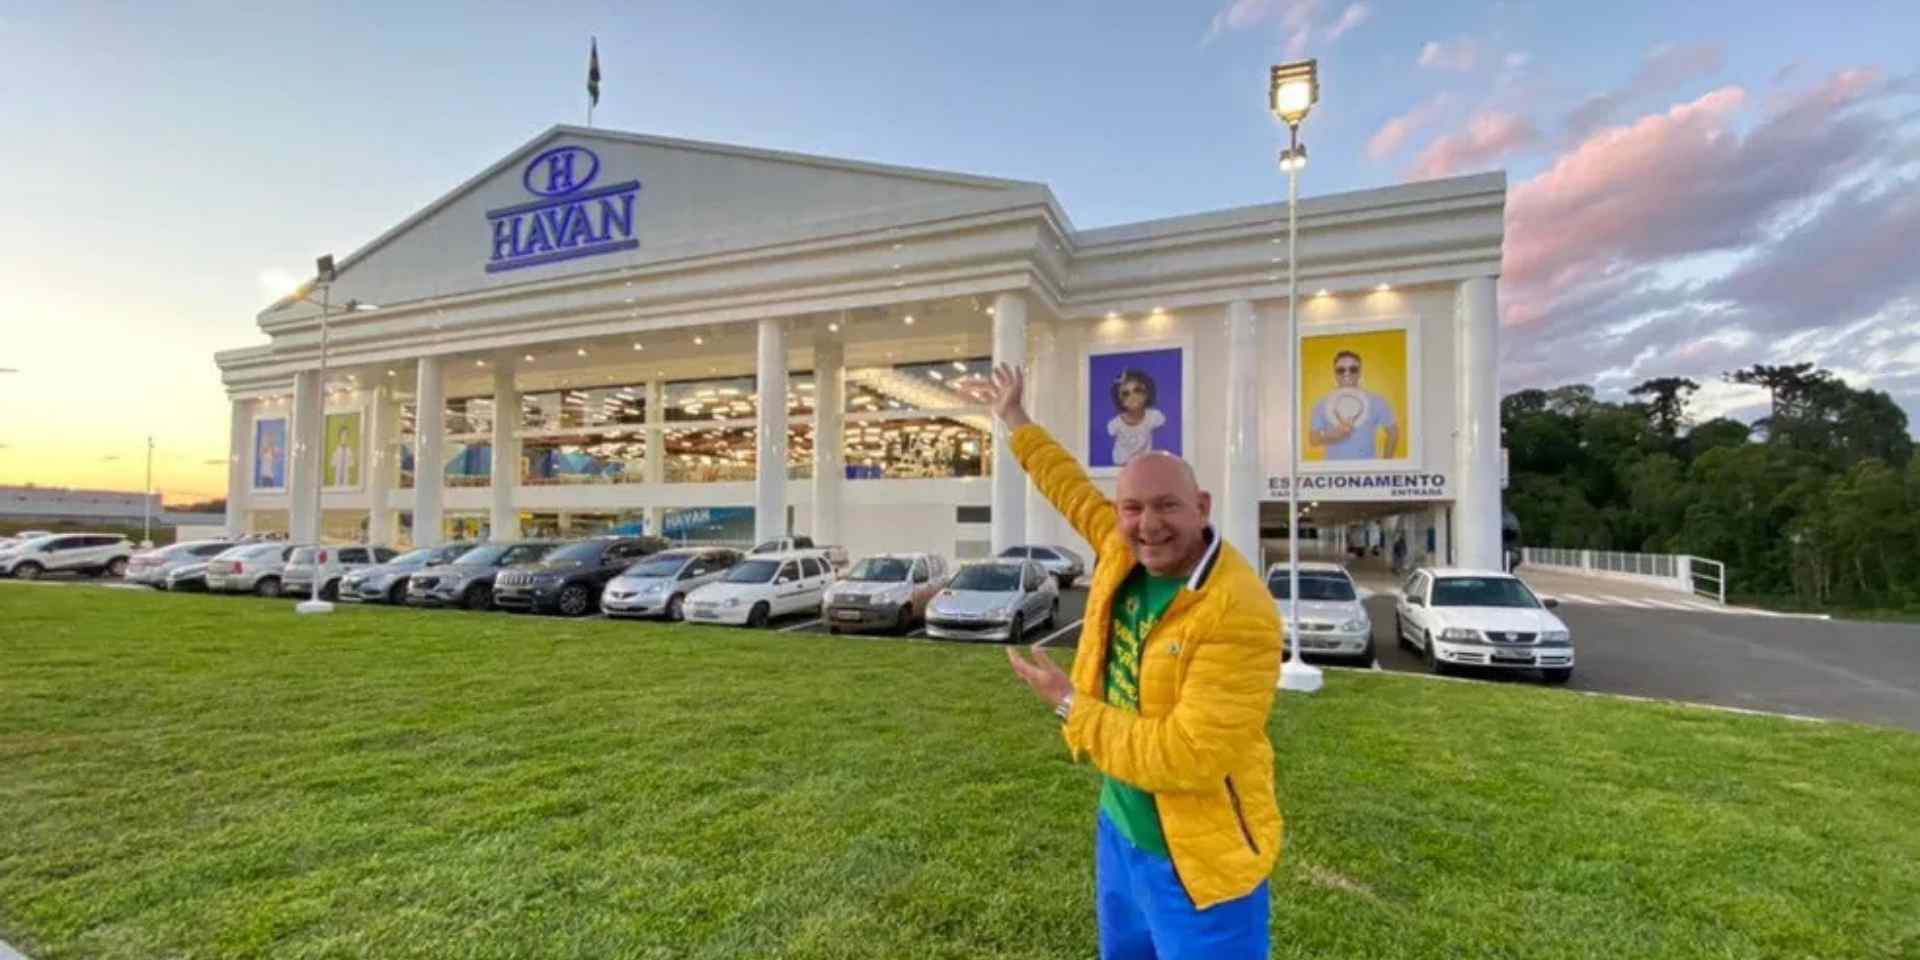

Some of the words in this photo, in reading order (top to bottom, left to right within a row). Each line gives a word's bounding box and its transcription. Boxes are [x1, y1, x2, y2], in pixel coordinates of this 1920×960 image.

[547, 153, 575, 192] H
[489, 194, 635, 261] HAVAN
[1269, 474, 1446, 490] ESTACIONAMENTO
